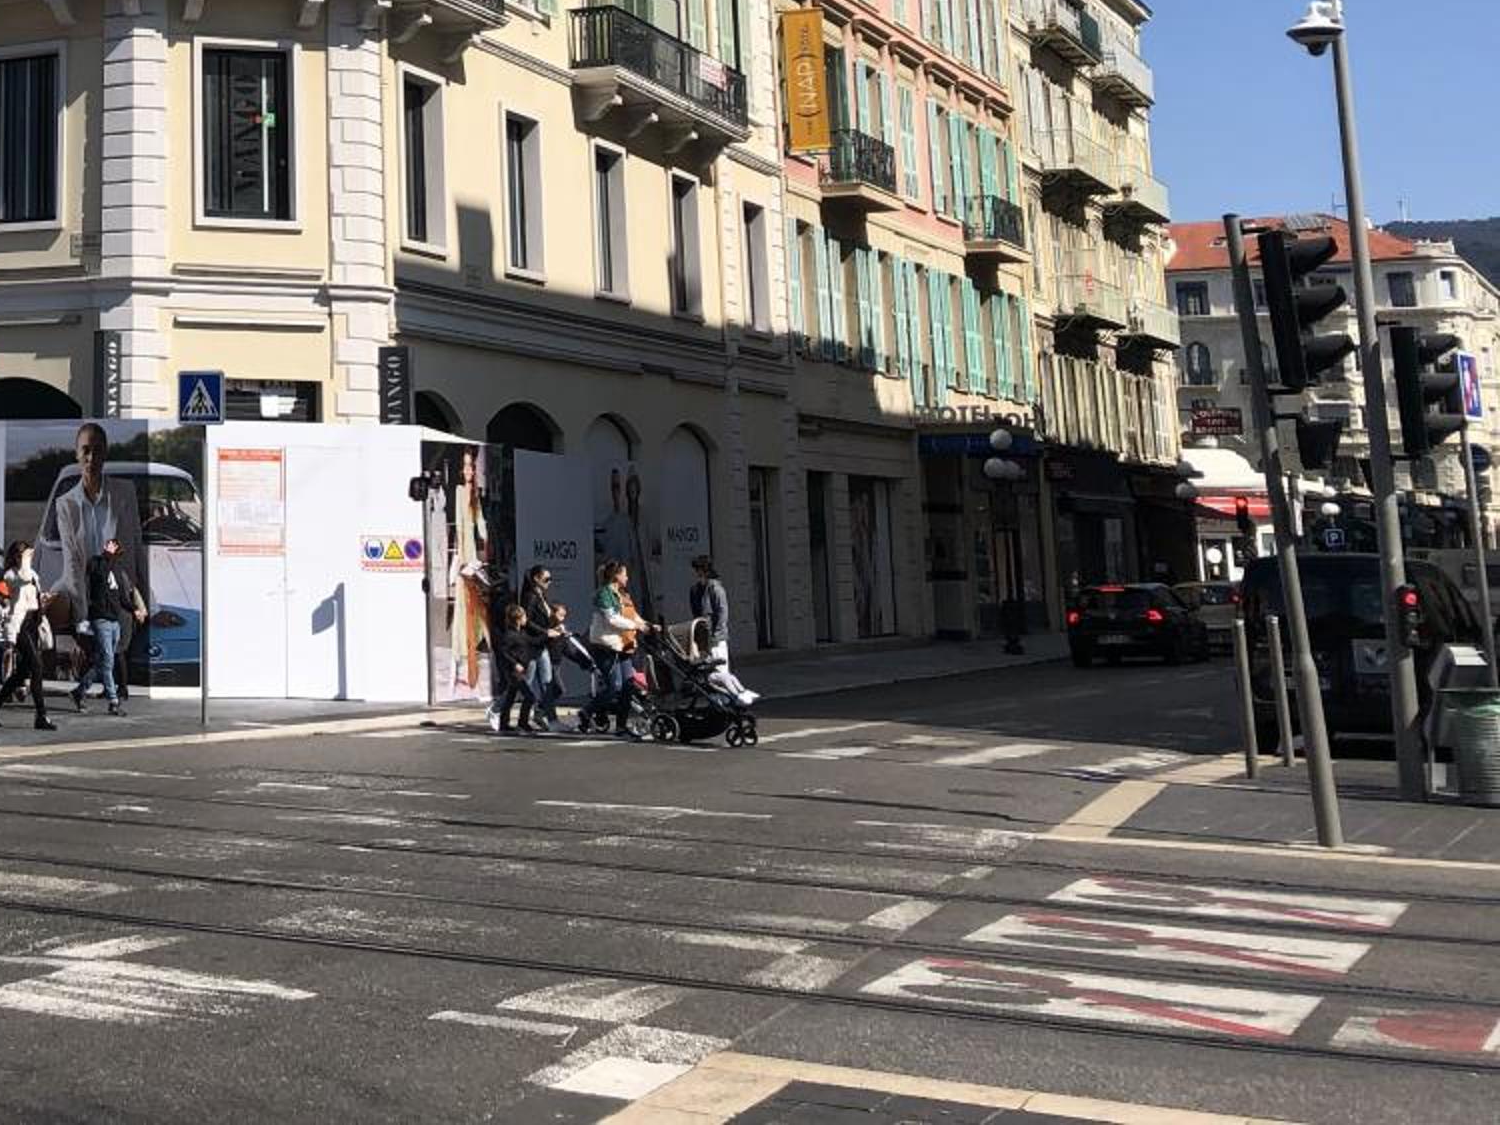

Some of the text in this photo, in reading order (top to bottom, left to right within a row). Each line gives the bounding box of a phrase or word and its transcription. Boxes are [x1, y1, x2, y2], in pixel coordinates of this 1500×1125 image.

[107, 340, 119, 418] MANGO
[667, 525, 699, 543] MANGO
[534, 539, 577, 559] MANGO
